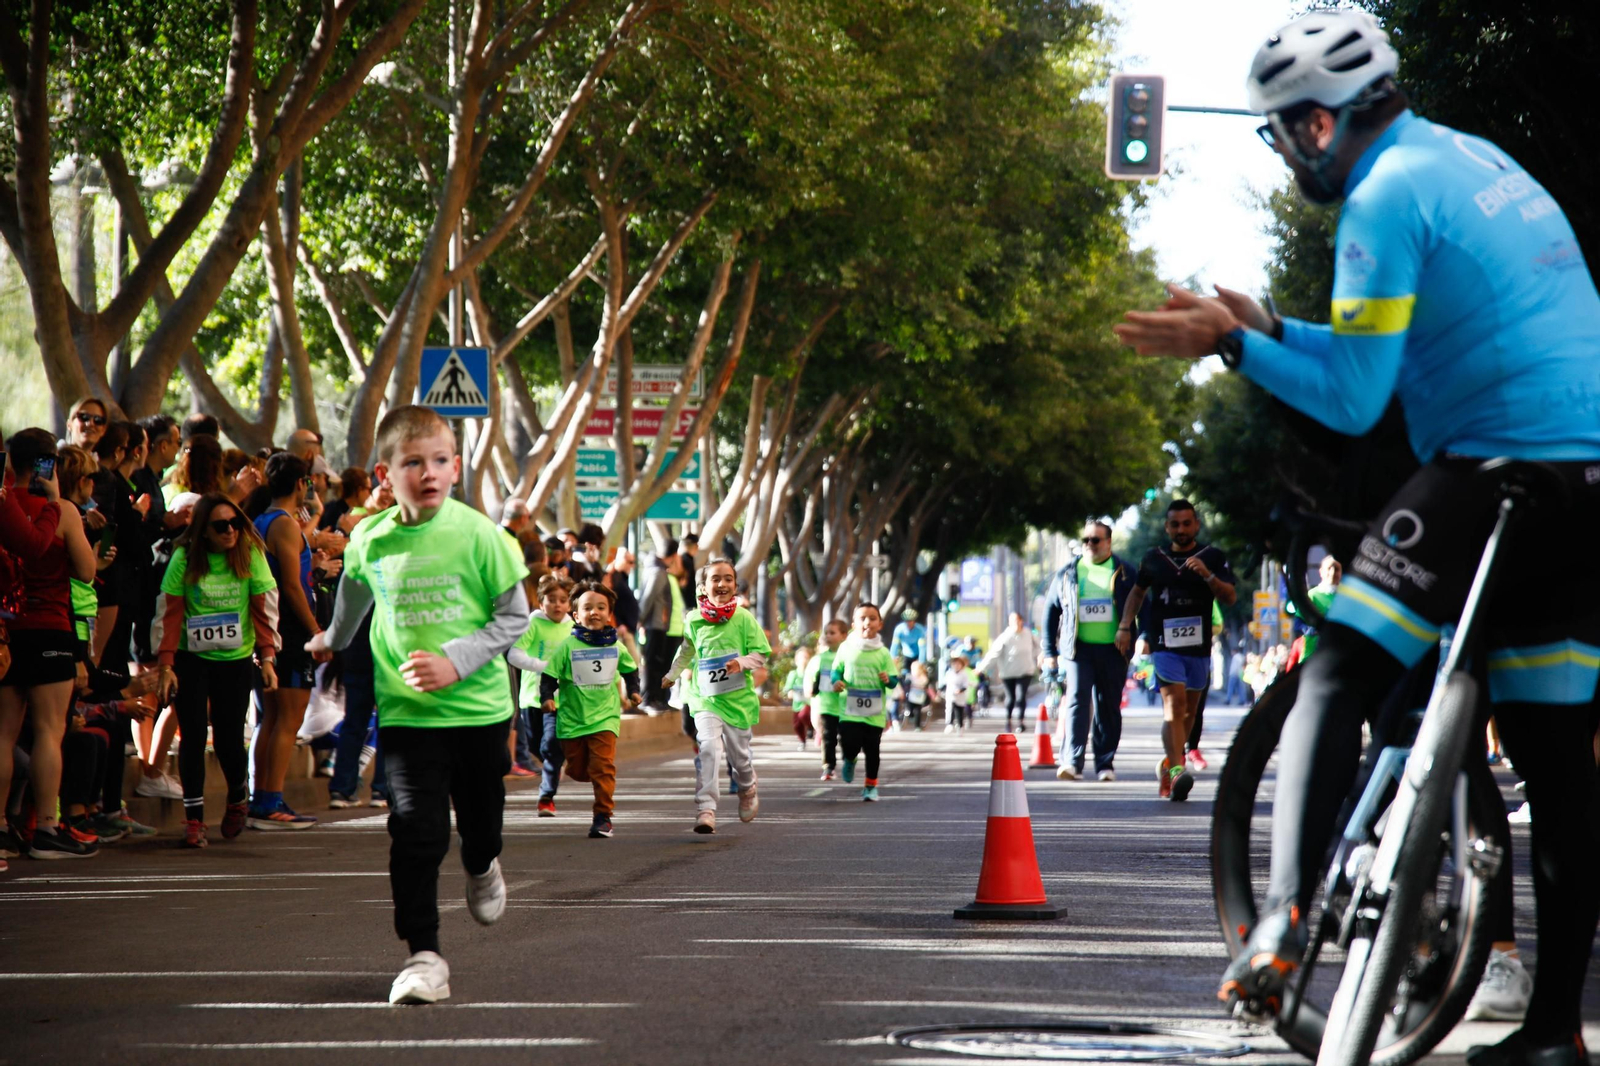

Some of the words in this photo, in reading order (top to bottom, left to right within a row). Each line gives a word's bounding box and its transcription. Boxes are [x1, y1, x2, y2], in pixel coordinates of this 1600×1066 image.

[406, 572, 461, 588] marcha
[390, 589, 442, 606] contra
[445, 584, 461, 600] el
[1085, 605, 1106, 614] 903
[193, 625, 237, 641] 1015
[1172, 627, 1196, 638] 522
[592, 660, 602, 673] 3
[709, 668, 729, 683] 22
[856, 698, 872, 708] 90
